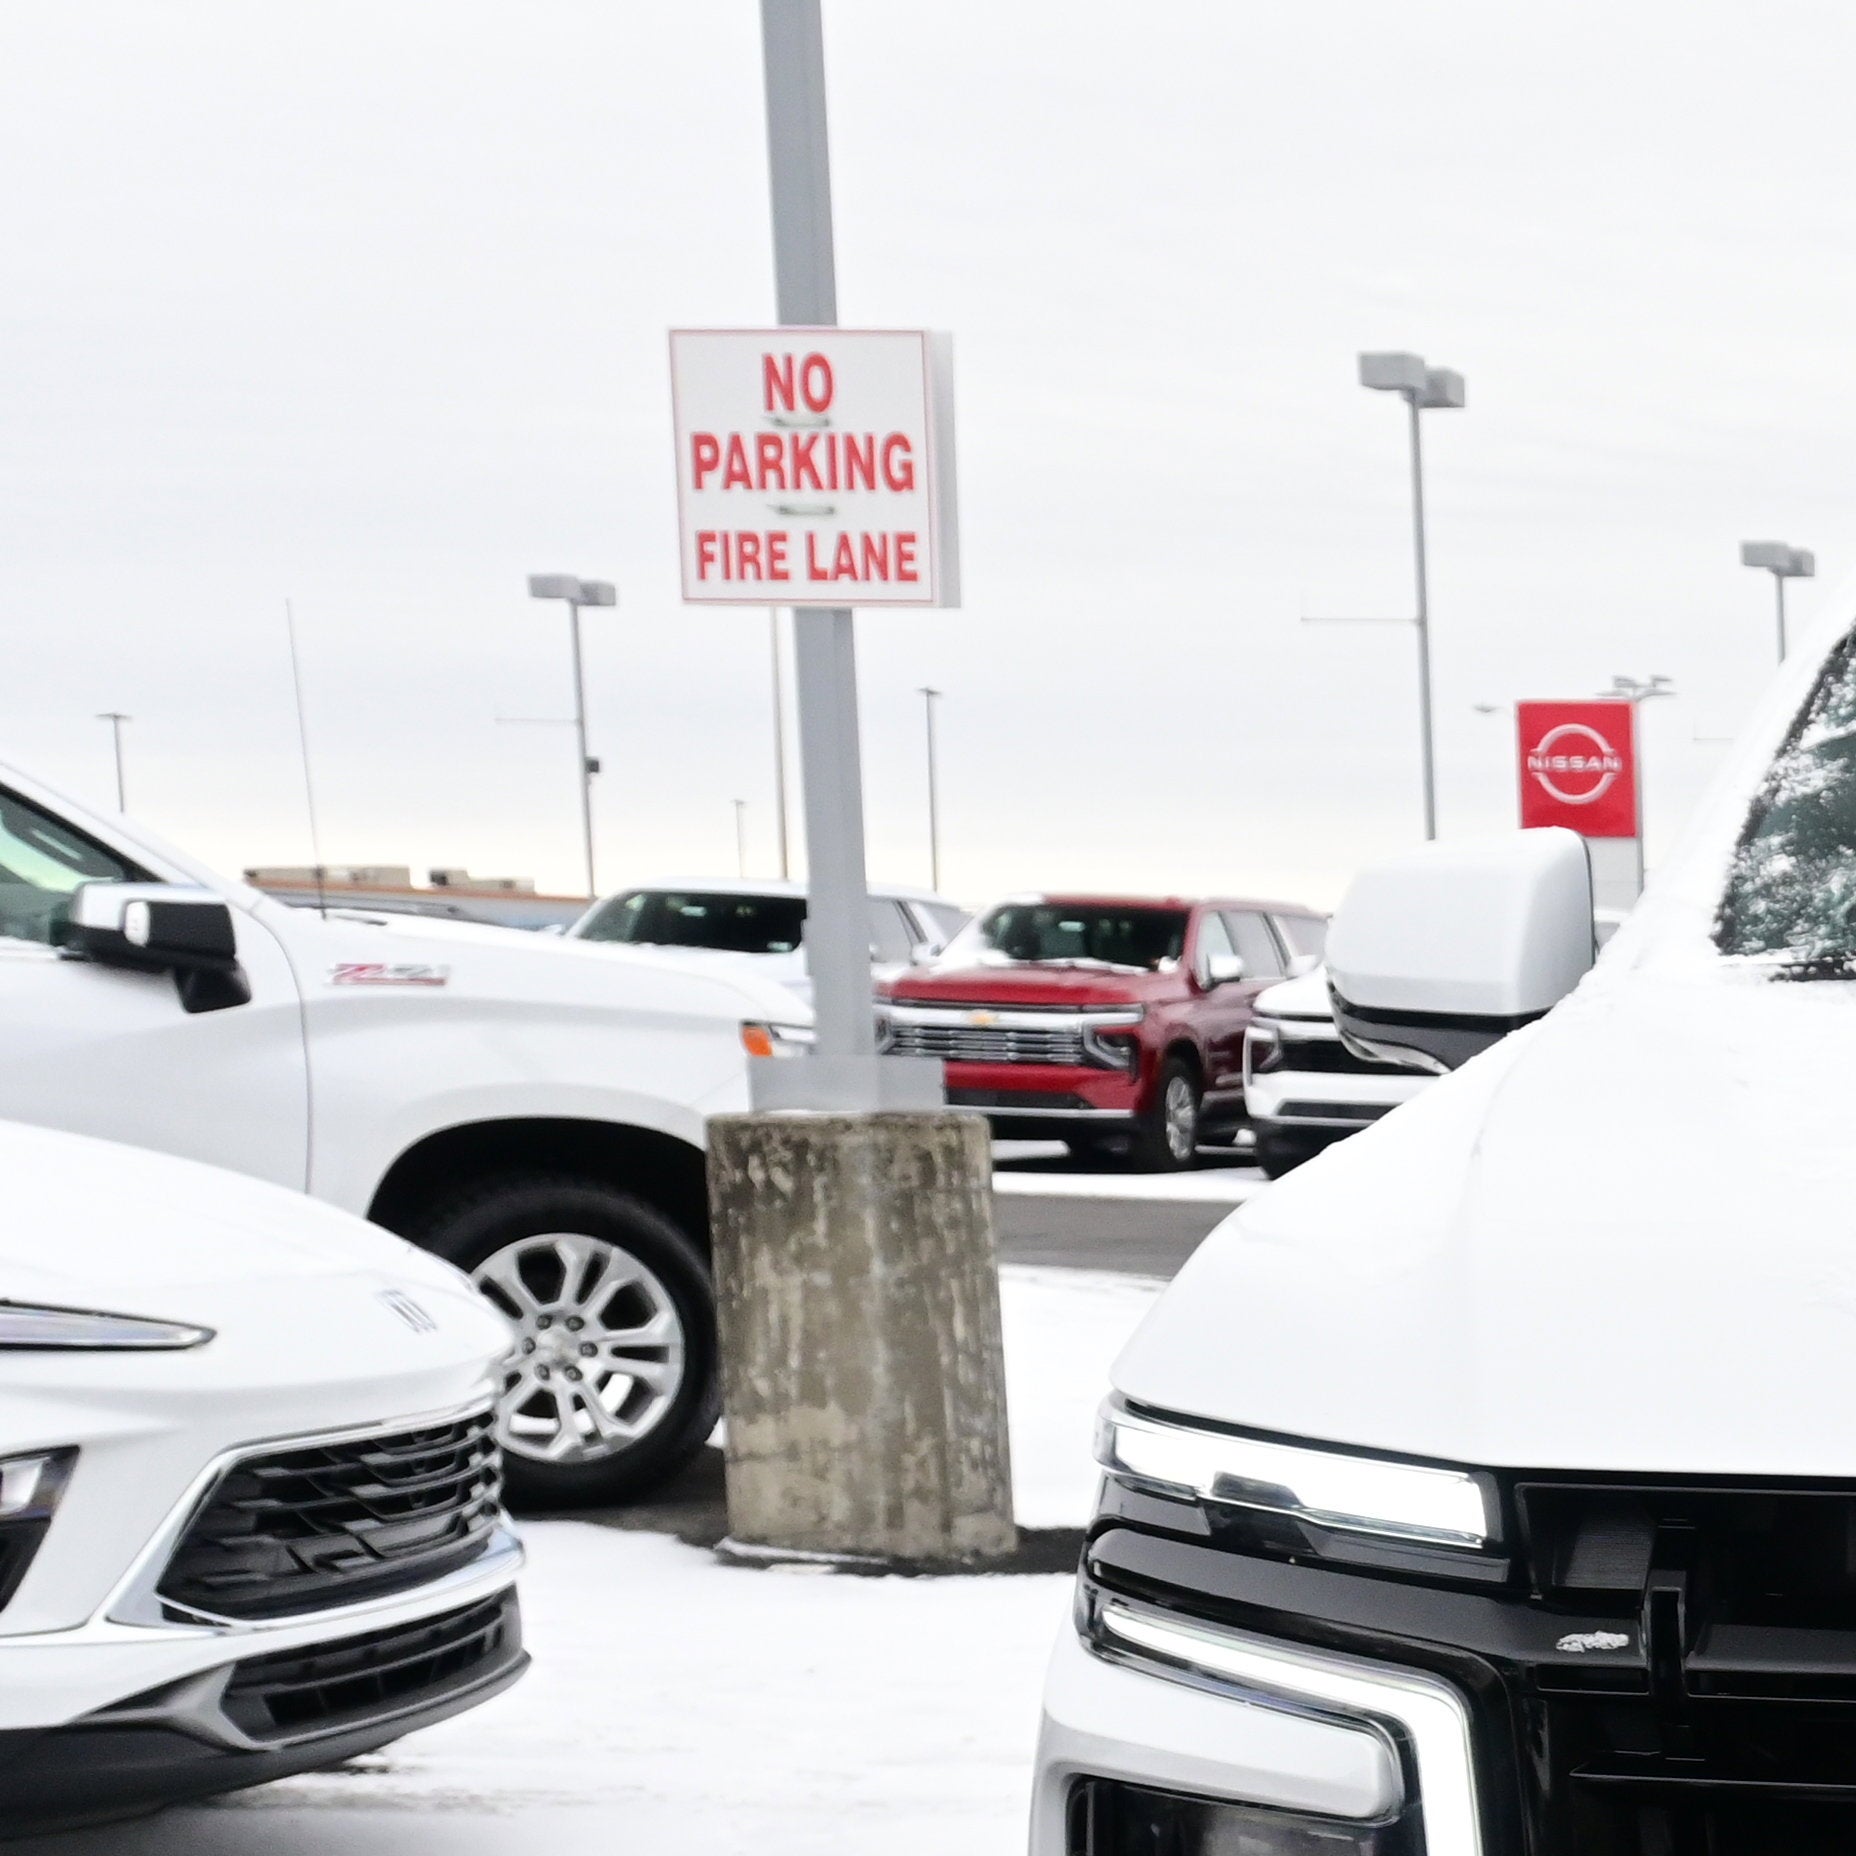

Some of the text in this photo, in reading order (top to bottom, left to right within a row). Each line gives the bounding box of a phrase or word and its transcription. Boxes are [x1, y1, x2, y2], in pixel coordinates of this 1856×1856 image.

[762, 353, 834, 413] NO
[691, 432, 915, 491] PARKING
[696, 530, 919, 582] FIRE LANE
[1527, 755, 1622, 772] NISSAN
